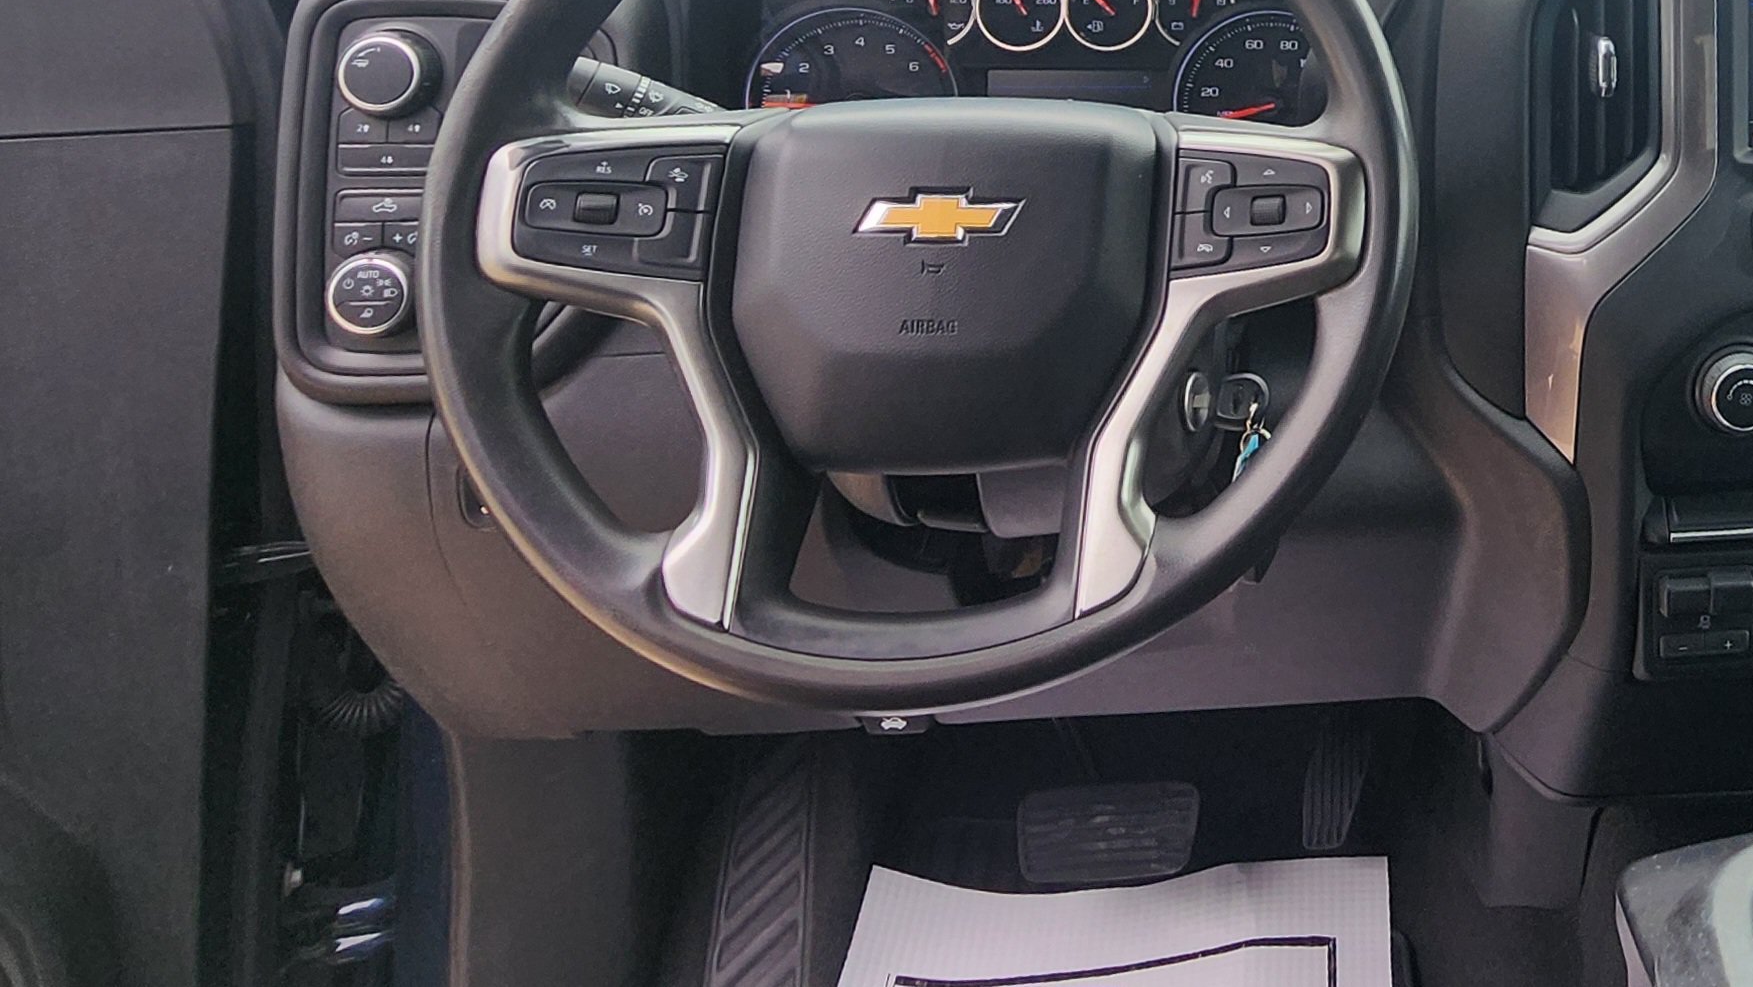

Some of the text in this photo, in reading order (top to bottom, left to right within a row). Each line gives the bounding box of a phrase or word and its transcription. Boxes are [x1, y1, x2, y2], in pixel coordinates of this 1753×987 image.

[799, 63, 810, 73] 2
[823, 45, 835, 55] 3
[854, 37, 866, 47] 4
[885, 44, 896, 54] 5
[908, 61, 919, 72] 6
[1201, 39, 1298, 97] 20 40 60 80
[357, 270, 380, 279] AUTO
[898, 318, 959, 336] AIRBAG
